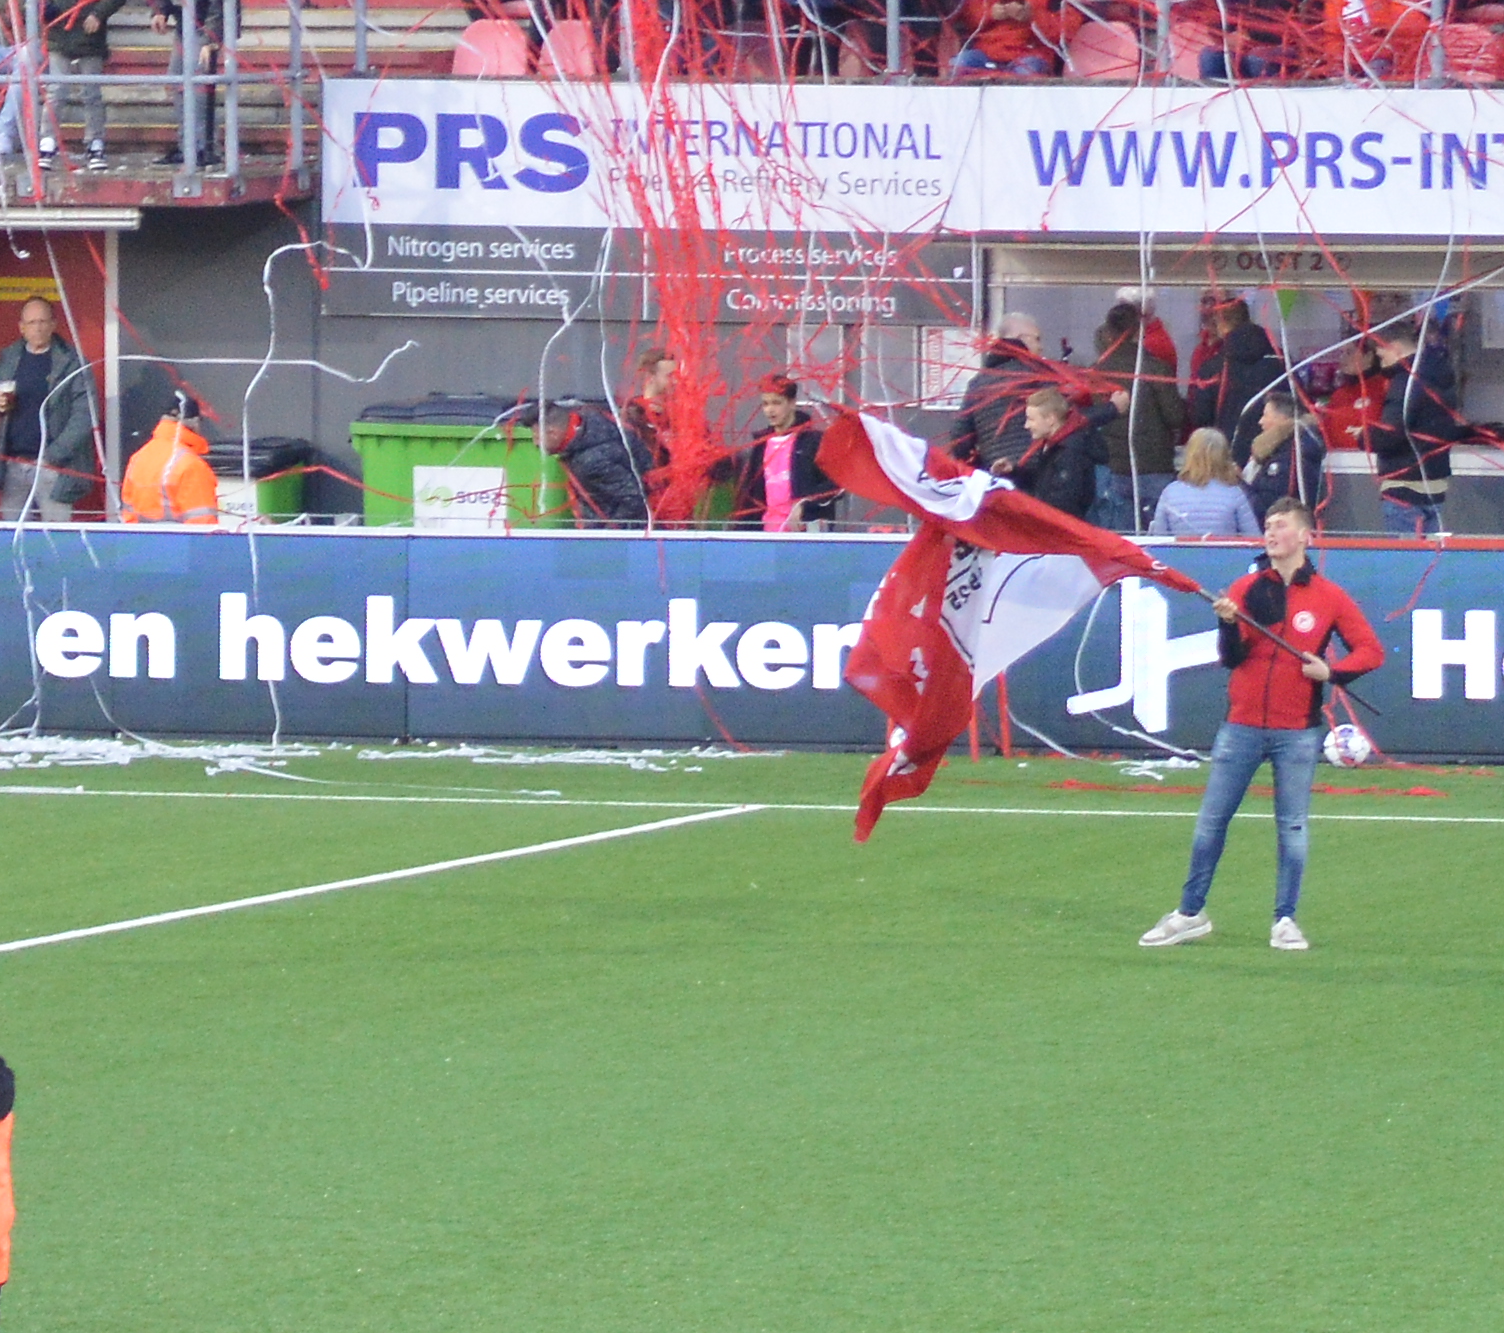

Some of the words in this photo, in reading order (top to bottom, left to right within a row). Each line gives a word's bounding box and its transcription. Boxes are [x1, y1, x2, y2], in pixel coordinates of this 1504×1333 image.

[353, 112, 590, 193] PRS
[838, 172, 942, 197] Services
[388, 236, 482, 263] Nitrogen
[487, 239, 575, 261] services
[1237, 251, 1303, 272] OOST
[1310, 251, 1324, 271] 2
[392, 280, 479, 308] Pipeline
[484, 283, 571, 308] services
[37, 609, 176, 681] en
